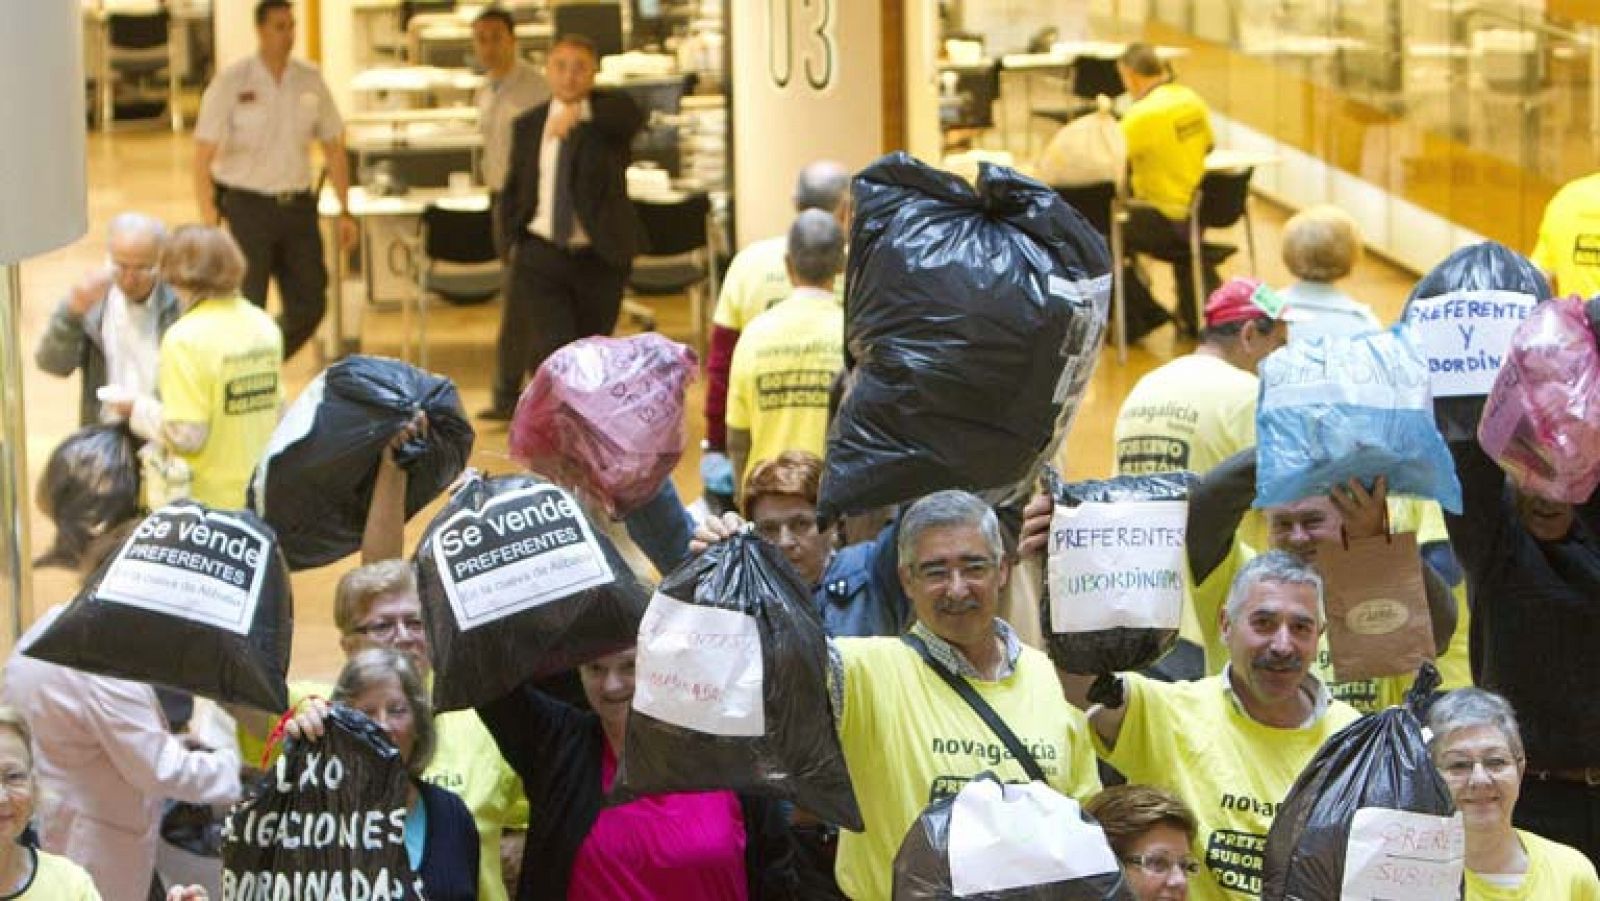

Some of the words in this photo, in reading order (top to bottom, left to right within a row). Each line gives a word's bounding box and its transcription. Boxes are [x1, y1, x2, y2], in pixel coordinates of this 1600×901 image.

[767, 0, 832, 91] 03
[1457, 324, 1476, 351] Y
[139, 514, 173, 540] Se
[178, 518, 260, 569] vende
[442, 524, 484, 557] Se
[487, 495, 576, 537] vende
[126, 543, 247, 586] PREFERENTES
[454, 527, 579, 579] PREFERENTES
